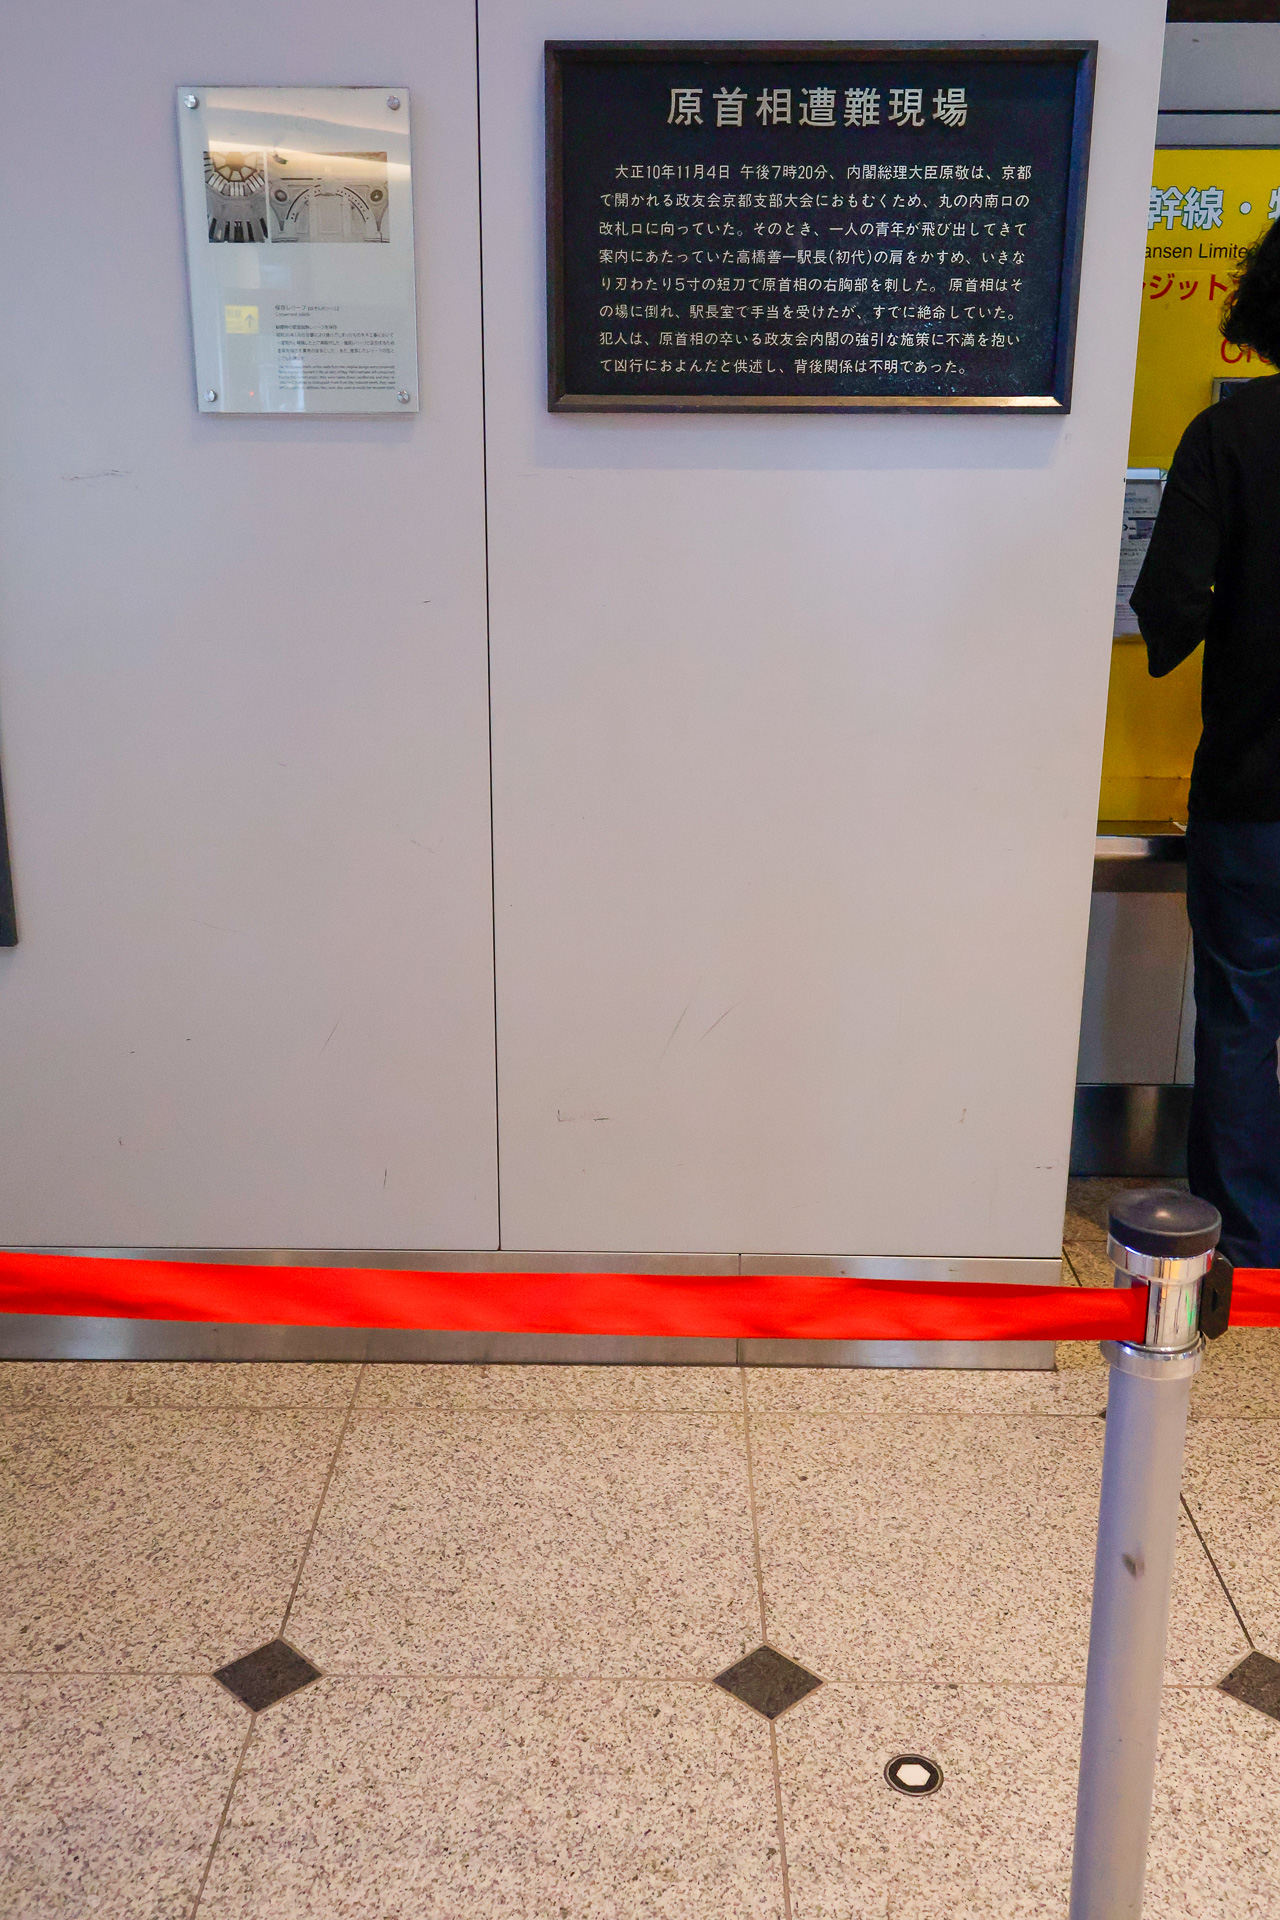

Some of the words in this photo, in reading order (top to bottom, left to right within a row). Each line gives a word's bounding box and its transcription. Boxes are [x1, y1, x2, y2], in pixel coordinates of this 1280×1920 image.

[667, 86, 968, 127] 原首相遭難現場
[615, 164, 729, 180] 大正10年11月4日
[600, 192, 1030, 208] で開かれる政友会京都支部大会におもむくため、丸の内南口の
[599, 221, 1027, 237] 改札口に向っていた。そのとき、一人の青年が飛び出してきて
[1142, 273, 1240, 301] ジット
[599, 304, 1015, 320] の場に倒れ、駅長室で手当を受けたが、すでに絶命していた。
[600, 358, 966, 375] て凶行におよんだと供述し、背後関係は不明であった。
